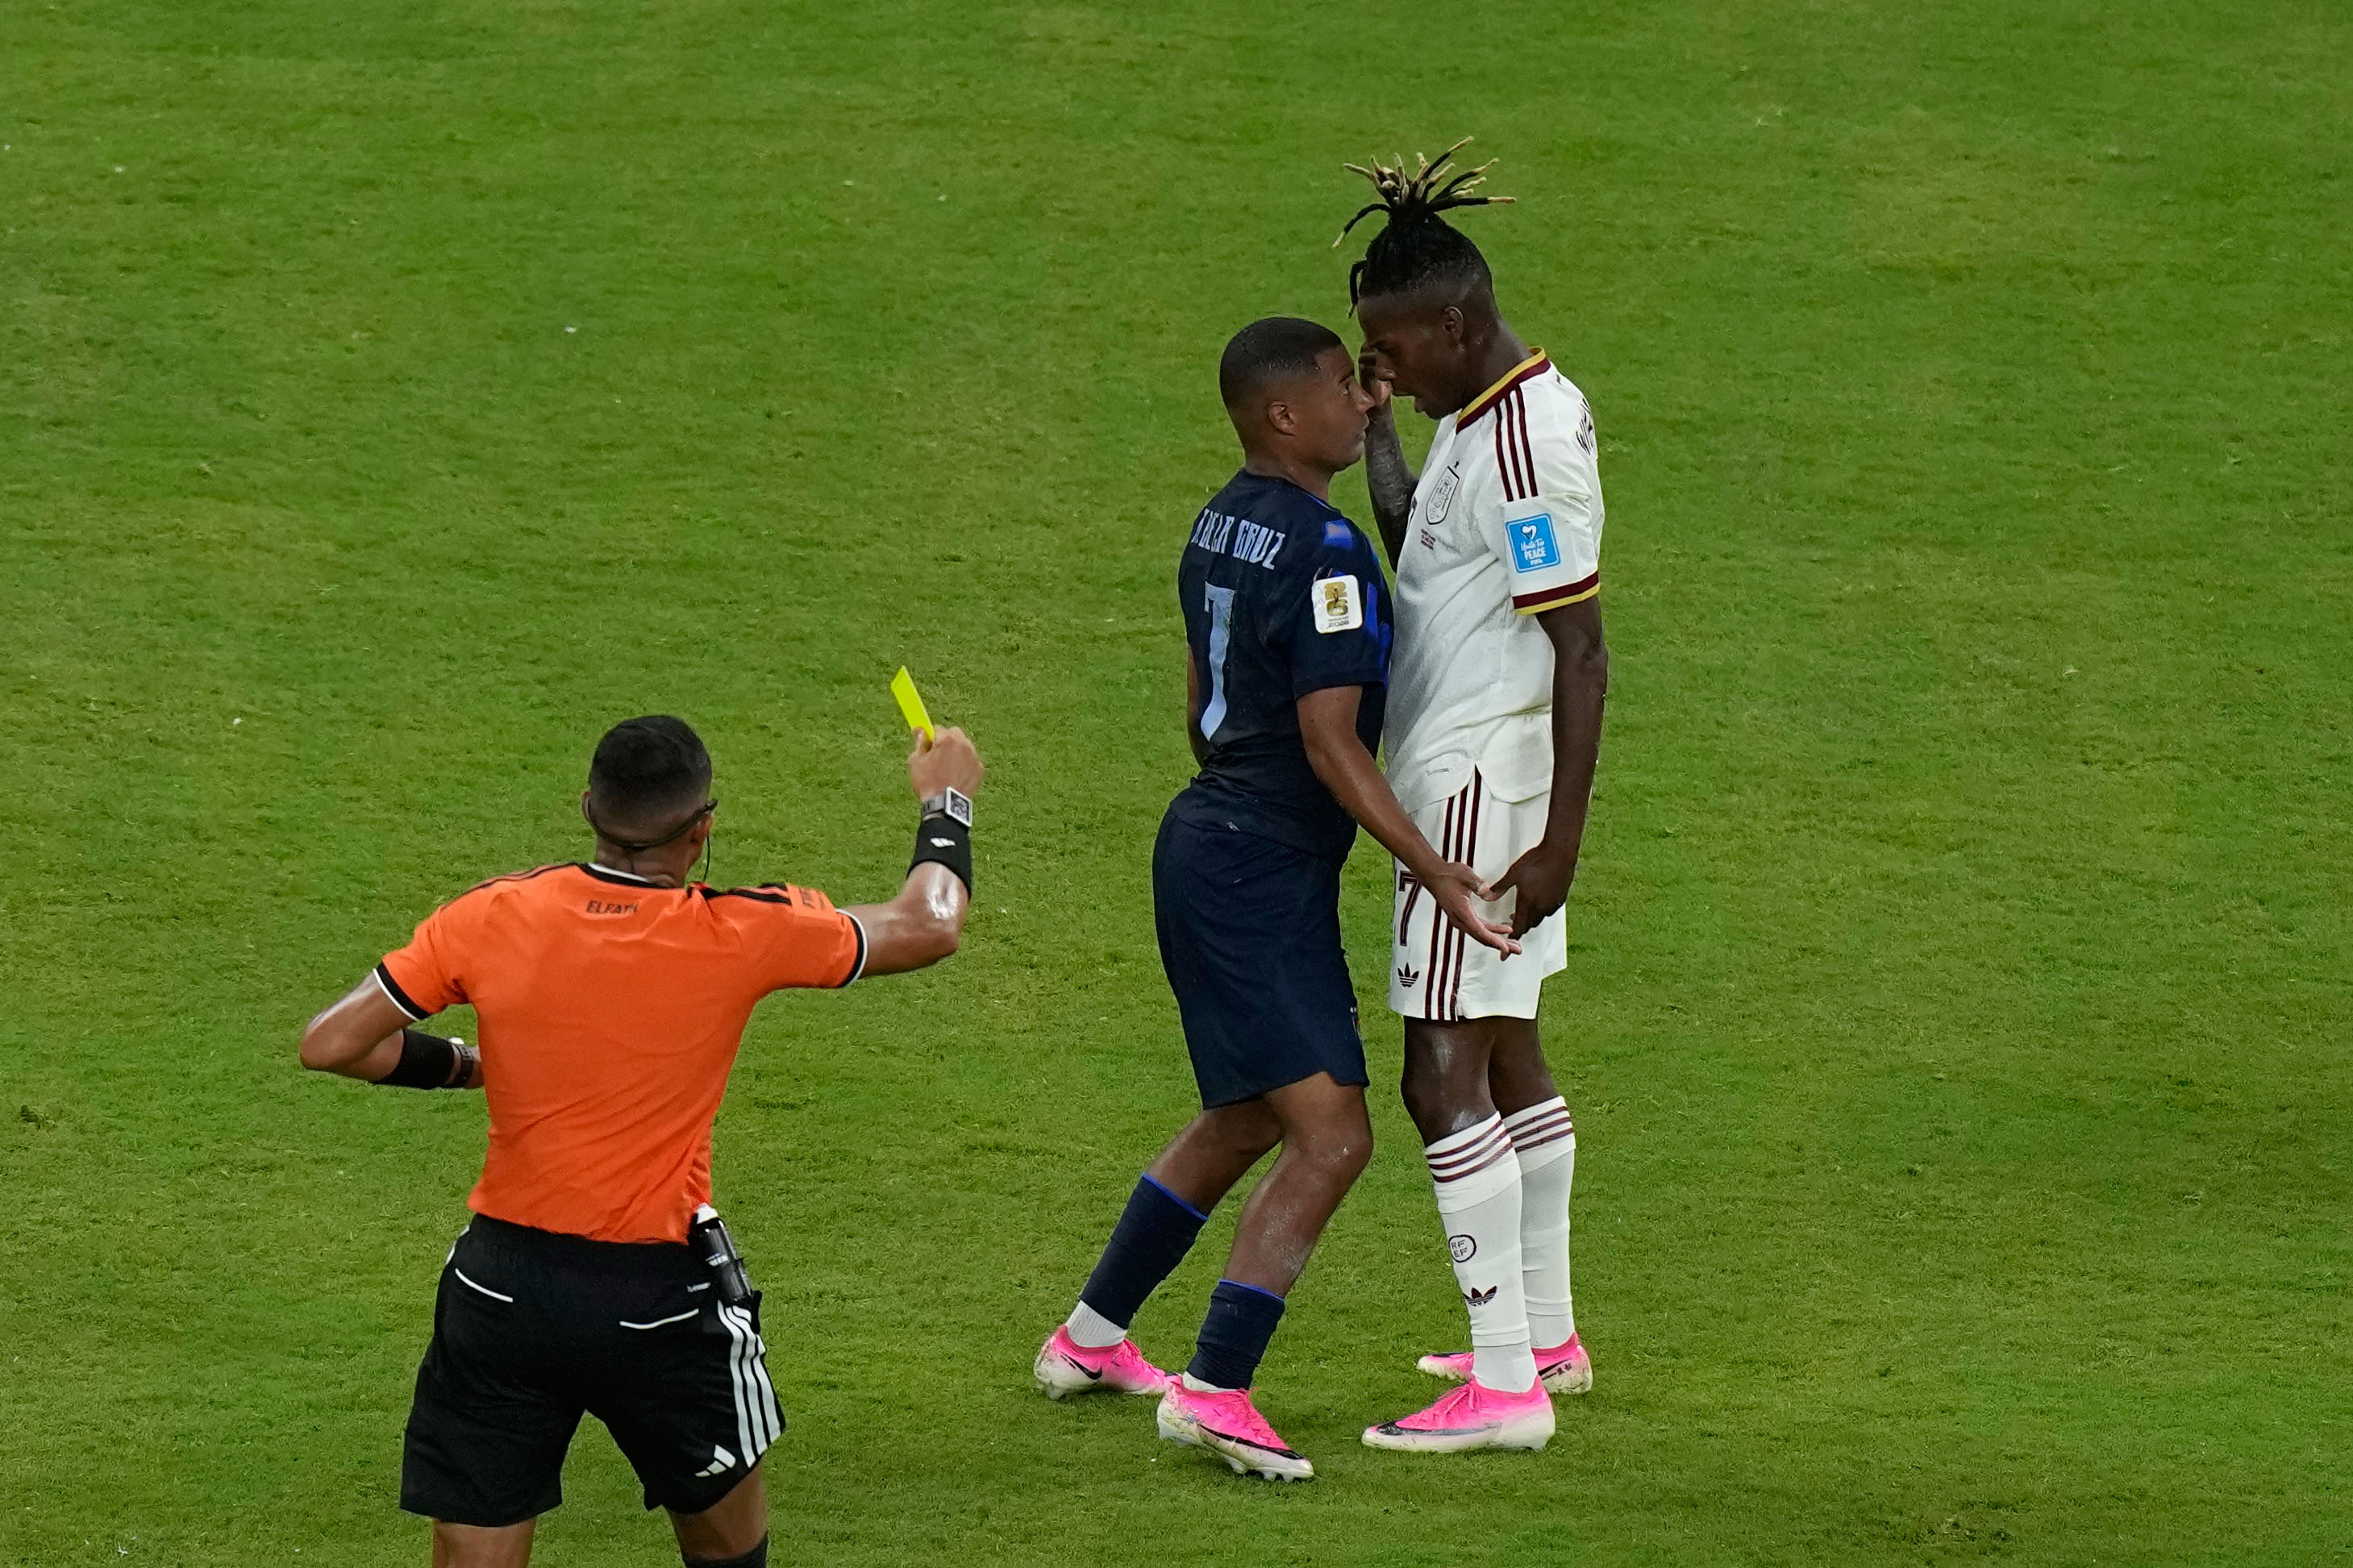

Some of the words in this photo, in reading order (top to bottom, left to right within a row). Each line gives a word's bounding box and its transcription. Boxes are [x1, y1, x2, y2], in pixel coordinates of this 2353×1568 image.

[1233, 519, 1285, 570] CRUZ
[1524, 547, 1547, 561] PEACE
[1201, 581, 1236, 742] 7
[1451, 1239, 1465, 1250] RF
[1453, 1247, 1468, 1258] EF
